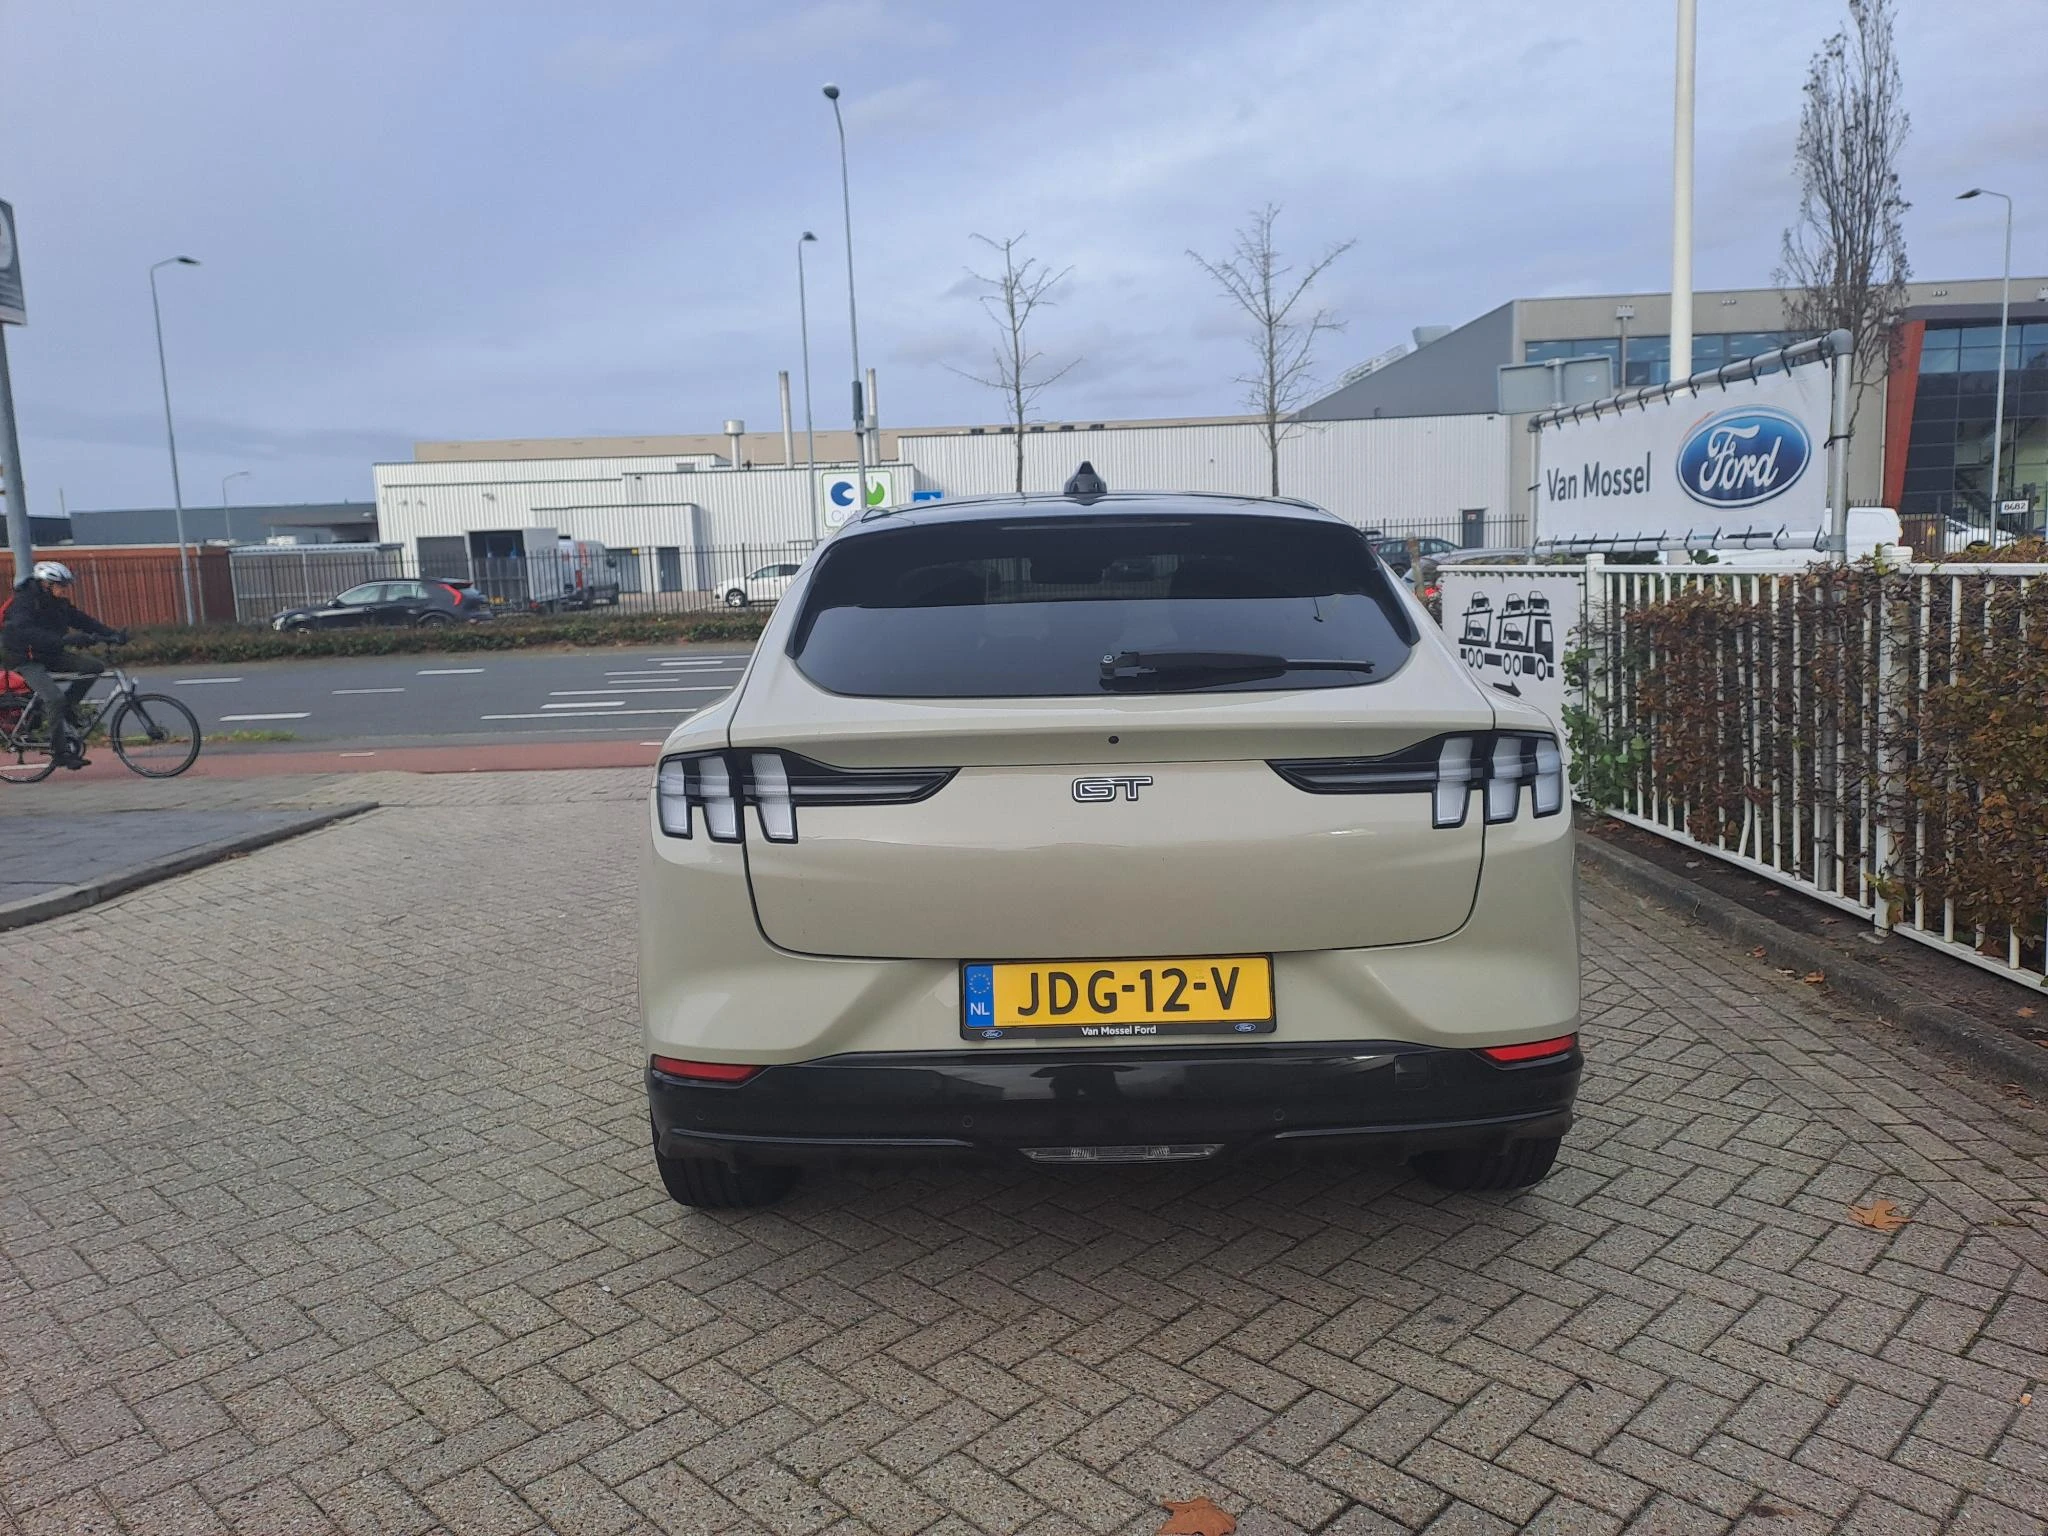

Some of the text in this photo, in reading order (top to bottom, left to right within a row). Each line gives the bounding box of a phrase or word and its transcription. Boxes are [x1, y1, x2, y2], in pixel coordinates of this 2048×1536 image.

[1547, 451, 1652, 501] Van Mossel
[1699, 424, 1782, 492] Ford
[1072, 776, 1153, 802] GT
[970, 1002, 991, 1016] NL
[1017, 966, 1240, 1017] JDG-12-V
[1081, 1024, 1157, 1036] Van Mossel Ford
